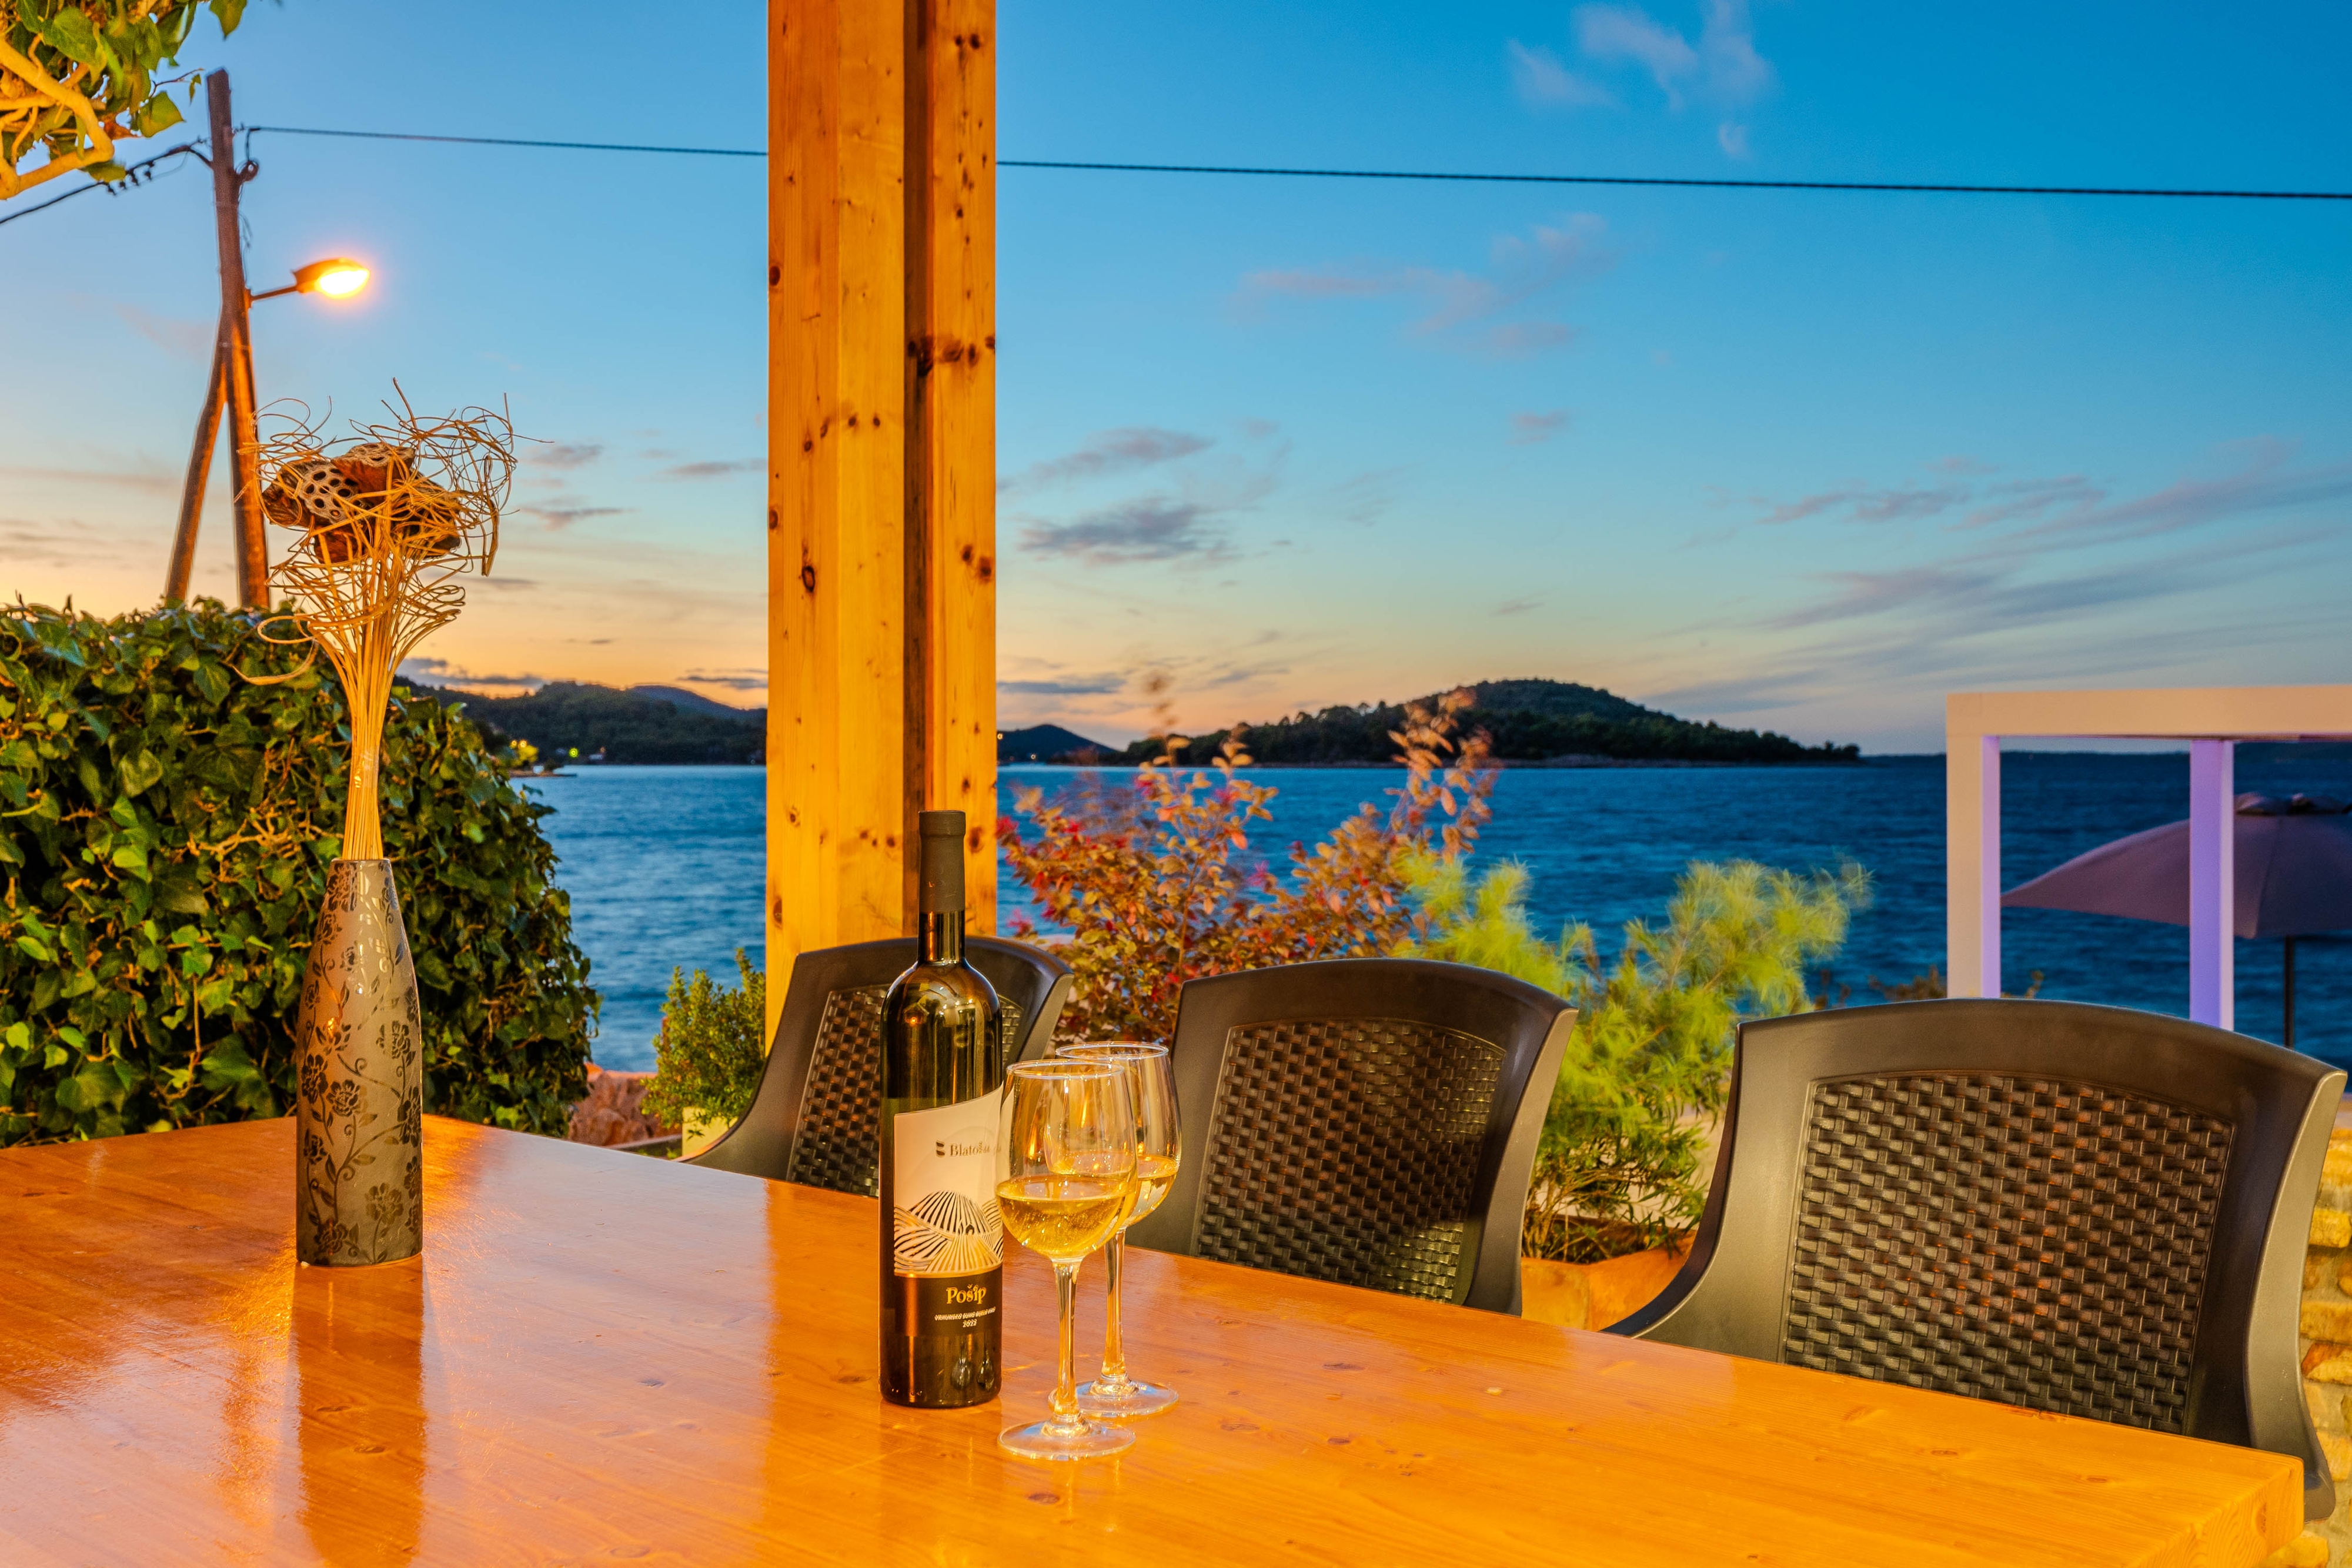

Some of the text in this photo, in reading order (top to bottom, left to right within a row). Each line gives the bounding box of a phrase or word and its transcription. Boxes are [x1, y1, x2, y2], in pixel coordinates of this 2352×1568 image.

[950, 1142, 978, 1156] Blato
[946, 1284, 987, 1304] Pošip
[963, 1319, 977, 1328] 2022
